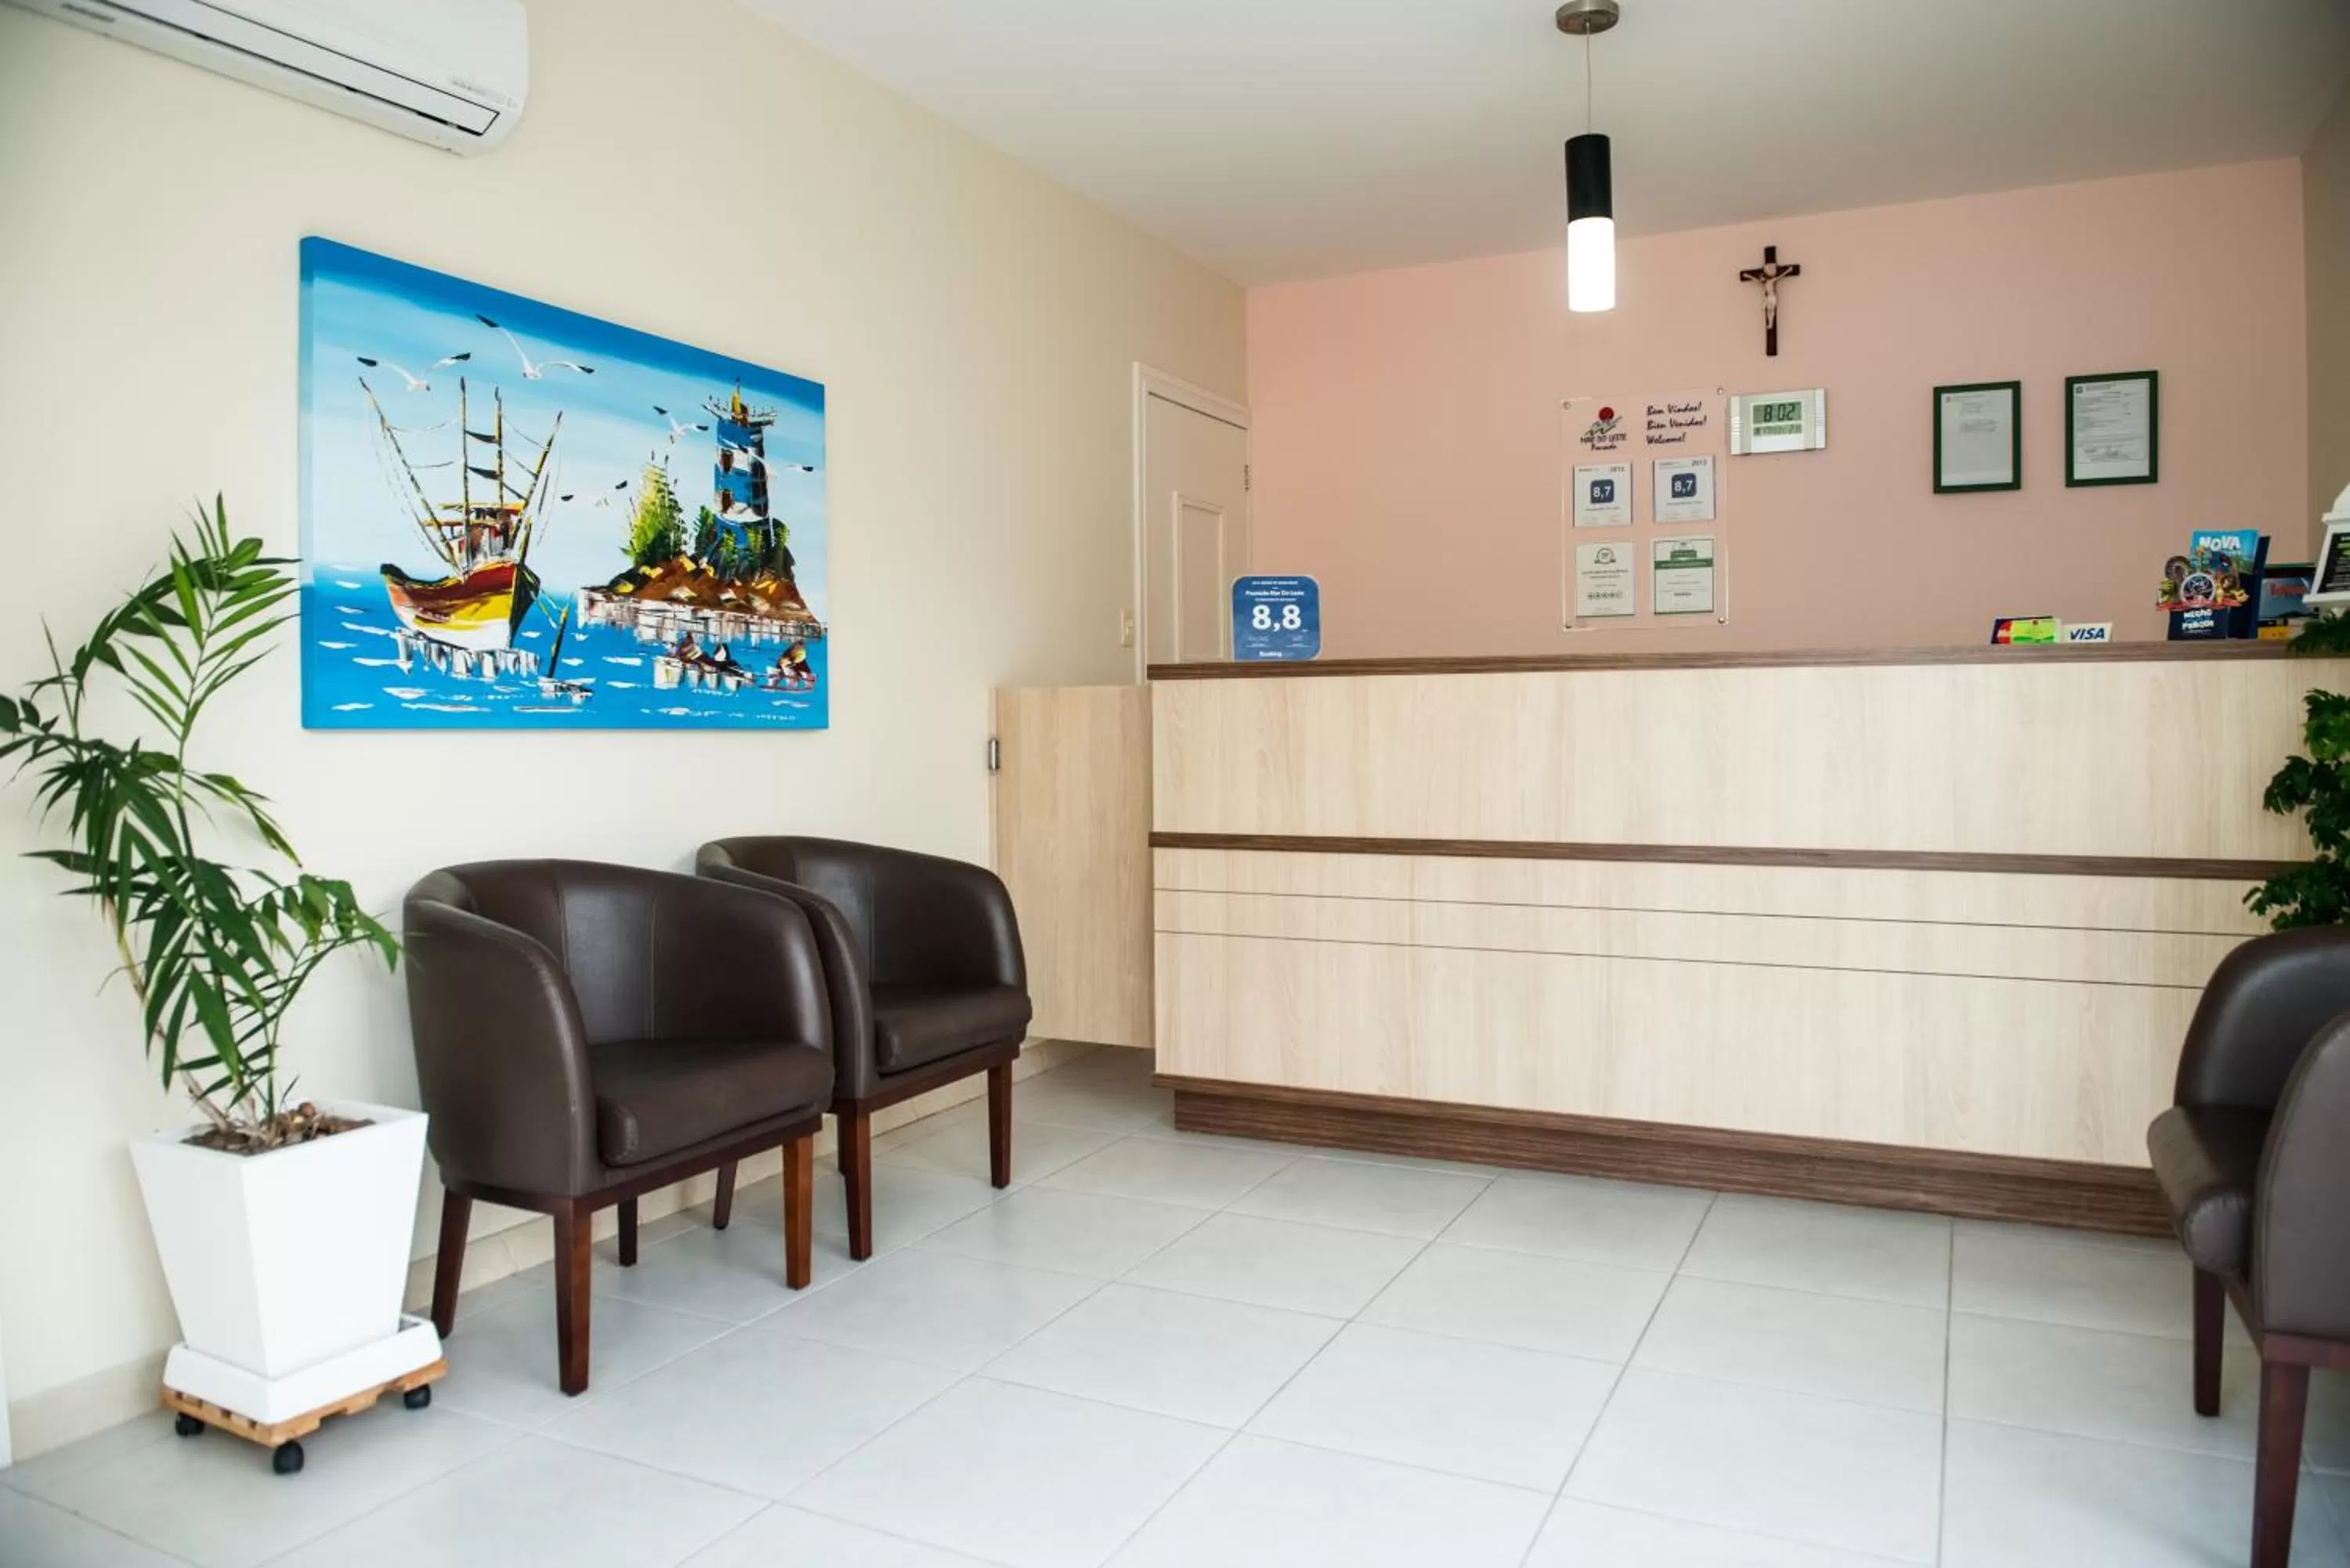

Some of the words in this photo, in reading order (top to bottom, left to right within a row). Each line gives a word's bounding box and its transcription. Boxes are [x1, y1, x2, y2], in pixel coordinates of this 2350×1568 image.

[1646, 432, 1687, 445] Welcome!
[1593, 486, 1611, 499] 8,7
[1673, 480, 1693, 493] 8,7
[2199, 536, 2241, 551] NOVA
[1253, 604, 1302, 632] 8,8
[2070, 627, 2105, 640] VISA
